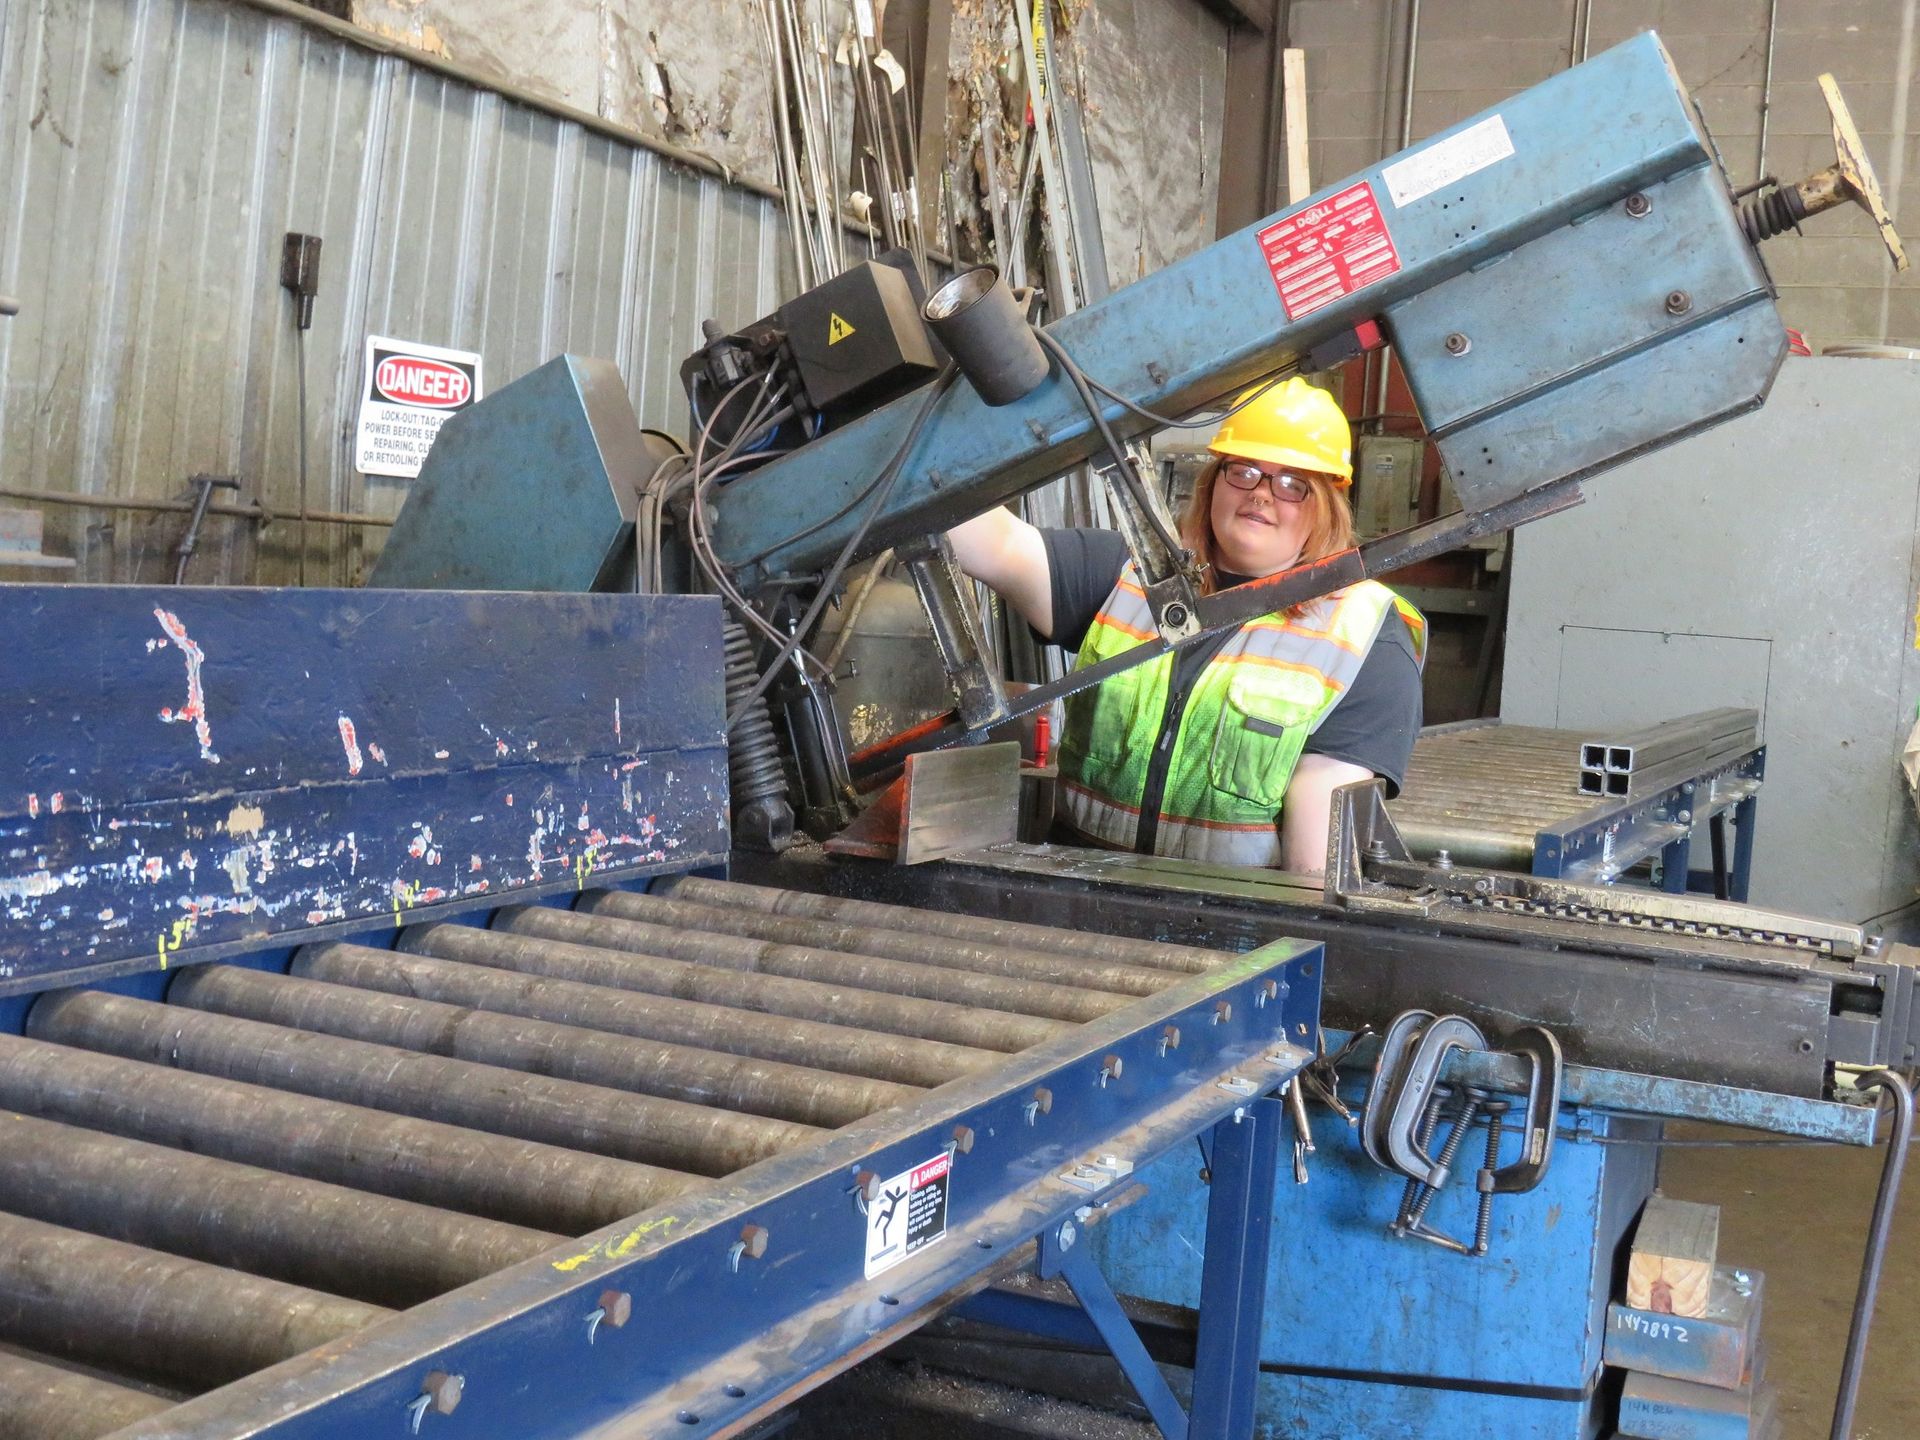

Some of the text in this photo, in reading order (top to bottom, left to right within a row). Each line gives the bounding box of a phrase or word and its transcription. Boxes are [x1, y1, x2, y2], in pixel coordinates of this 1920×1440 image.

[382, 362, 466, 400] DANGER
[365, 422, 391, 435] POWER
[393, 425, 422, 439] BEFORE
[374, 437, 416, 453] REPAIRING,
[364, 451, 374, 462] OR
[376, 452, 419, 466] RETOOLING
[921, 1160, 947, 1182] DANGER
